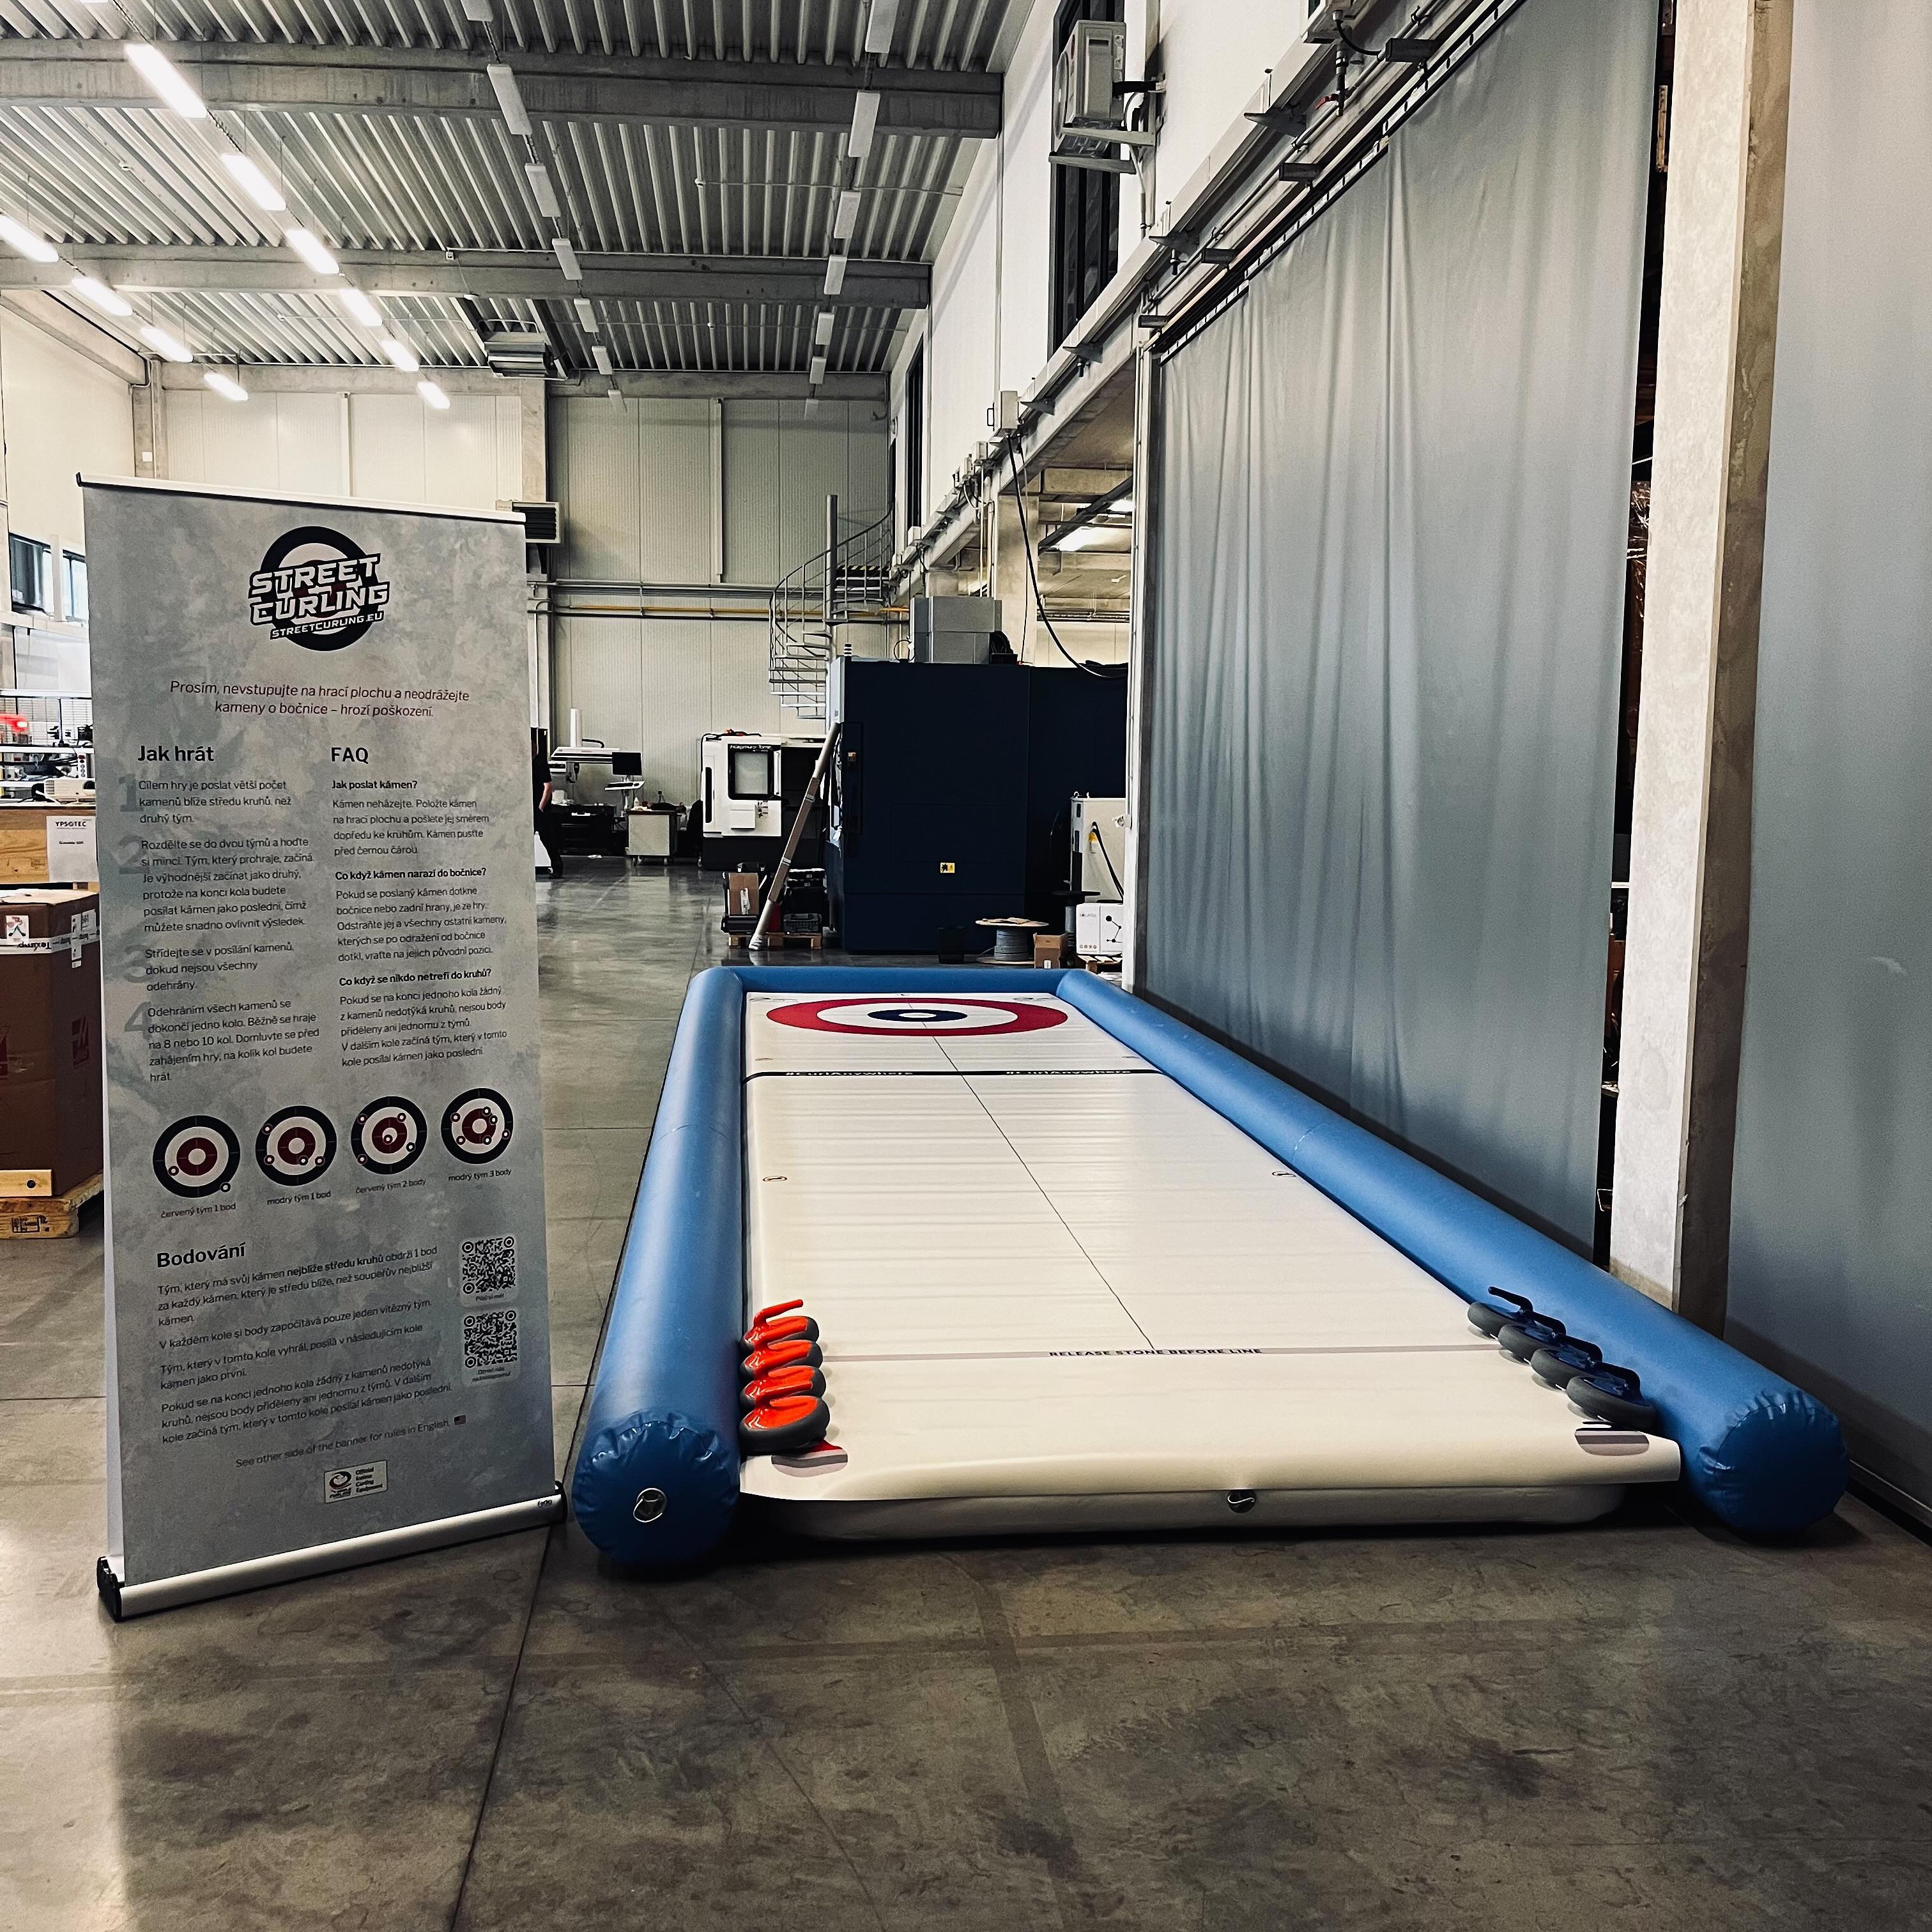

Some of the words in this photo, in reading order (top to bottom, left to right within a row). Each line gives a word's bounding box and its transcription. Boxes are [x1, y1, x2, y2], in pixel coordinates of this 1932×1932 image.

[250, 555, 379, 596] STREET
[252, 583, 389, 625] CURLING
[272, 611, 383, 638] STREETCURLING.EU
[223, 684, 298, 698] nevstupujte
[301, 687, 315, 696] na
[318, 686, 349, 696] hrací
[350, 686, 391, 699] plochu
[394, 690, 401, 698] a
[404, 689, 469, 702] neodrážejte
[215, 701, 265, 715] kameny
[268, 705, 276, 713] o
[279, 702, 327, 714] bočnice
[341, 703, 370, 715] hrozí
[137, 745, 170, 761] Jak
[174, 746, 214, 761] hrát
[331, 747, 368, 764] FAQ
[139, 780, 168, 790] Cílem
[171, 781, 187, 791] hry
[188, 782, 198, 791] je
[201, 780, 231, 790] poslat
[233, 780, 256, 789] větší
[259, 779, 286, 790] počet
[332, 779, 347, 788] Jak
[349, 780, 378, 790] poslat
[379, 780, 417, 788] kámen?
[332, 799, 364, 808] Kámen
[416, 799, 447, 808] Položte
[448, 799, 477, 808] kámen
[140, 813, 169, 824] druhý
[141, 839, 187, 850] Rozdělte
[204, 839, 217, 848] do
[219, 839, 243, 848] dvou
[246, 838, 270, 849] týmů
[280, 838, 309, 846] hoďte
[143, 871, 153, 883] Je
[155, 871, 211, 884] výhodnější
[213, 871, 248, 880] začínat
[249, 870, 270, 881] jako
[335, 871, 348, 880] Co
[349, 870, 371, 880] když
[373, 870, 405, 878] kámen
[407, 869, 436, 877] narazí
[437, 869, 448, 877] do
[449, 867, 486, 877] bočnice?
[142, 889, 183, 900] protože
[200, 889, 227, 897] konci
[229, 887, 250, 896] kola
[252, 886, 286, 895] budete
[336, 890, 365, 899] Pokud
[379, 888, 415, 898] poslaný
[417, 888, 447, 896] kámen
[449, 887, 477, 895] dotkne
[144, 922, 183, 932] můžete
[185, 921, 222, 930] snadno
[225, 919, 259, 928] ovlivnit
[337, 936, 371, 946] kterých
[399, 933, 439, 942] odražení
[441, 933, 452, 941] od
[454, 931, 485, 940] bočnice
[146, 965, 178, 974] dokud
[181, 965, 214, 974] nejsou
[217, 961, 257, 970] všechny
[339, 977, 352, 986] Co
[354, 976, 375, 986] když
[390, 973, 415, 982] nikdo
[417, 971, 449, 981] netrefí
[463, 968, 491, 978] kruhů?
[148, 1005, 204, 1016] Odehráním
[206, 1004, 236, 1013] všech
[238, 999, 277, 1011] kamenů
[164, 1039, 171, 1048] 8
[173, 1038, 199, 1047] nebo
[202, 1036, 214, 1046] 10
[236, 1032, 282, 1043] Domluvte
[298, 1028, 319, 1039] před
[157, 1241, 245, 1268] Bodování
[184, 1280, 210, 1291] který
[213, 1277, 227, 1287] má
[230, 1273, 249, 1285] svůj
[252, 1271, 284, 1281] kámen
[287, 1264, 323, 1276] nejblíže
[325, 1259, 355, 1271] středu
[356, 1254, 383, 1266] kruhů
[385, 1250, 412, 1261] obdrží
[420, 1246, 437, 1256] bod
[236, 1458, 254, 1468] See
[256, 1453, 282, 1463] other
[284, 1448, 305, 1458] side
[307, 1445, 317, 1454] of
[318, 1441, 334, 1452] the
[335, 1436, 368, 1450] banner
[369, 1433, 383, 1441] for
[384, 1428, 406, 1438] rules
